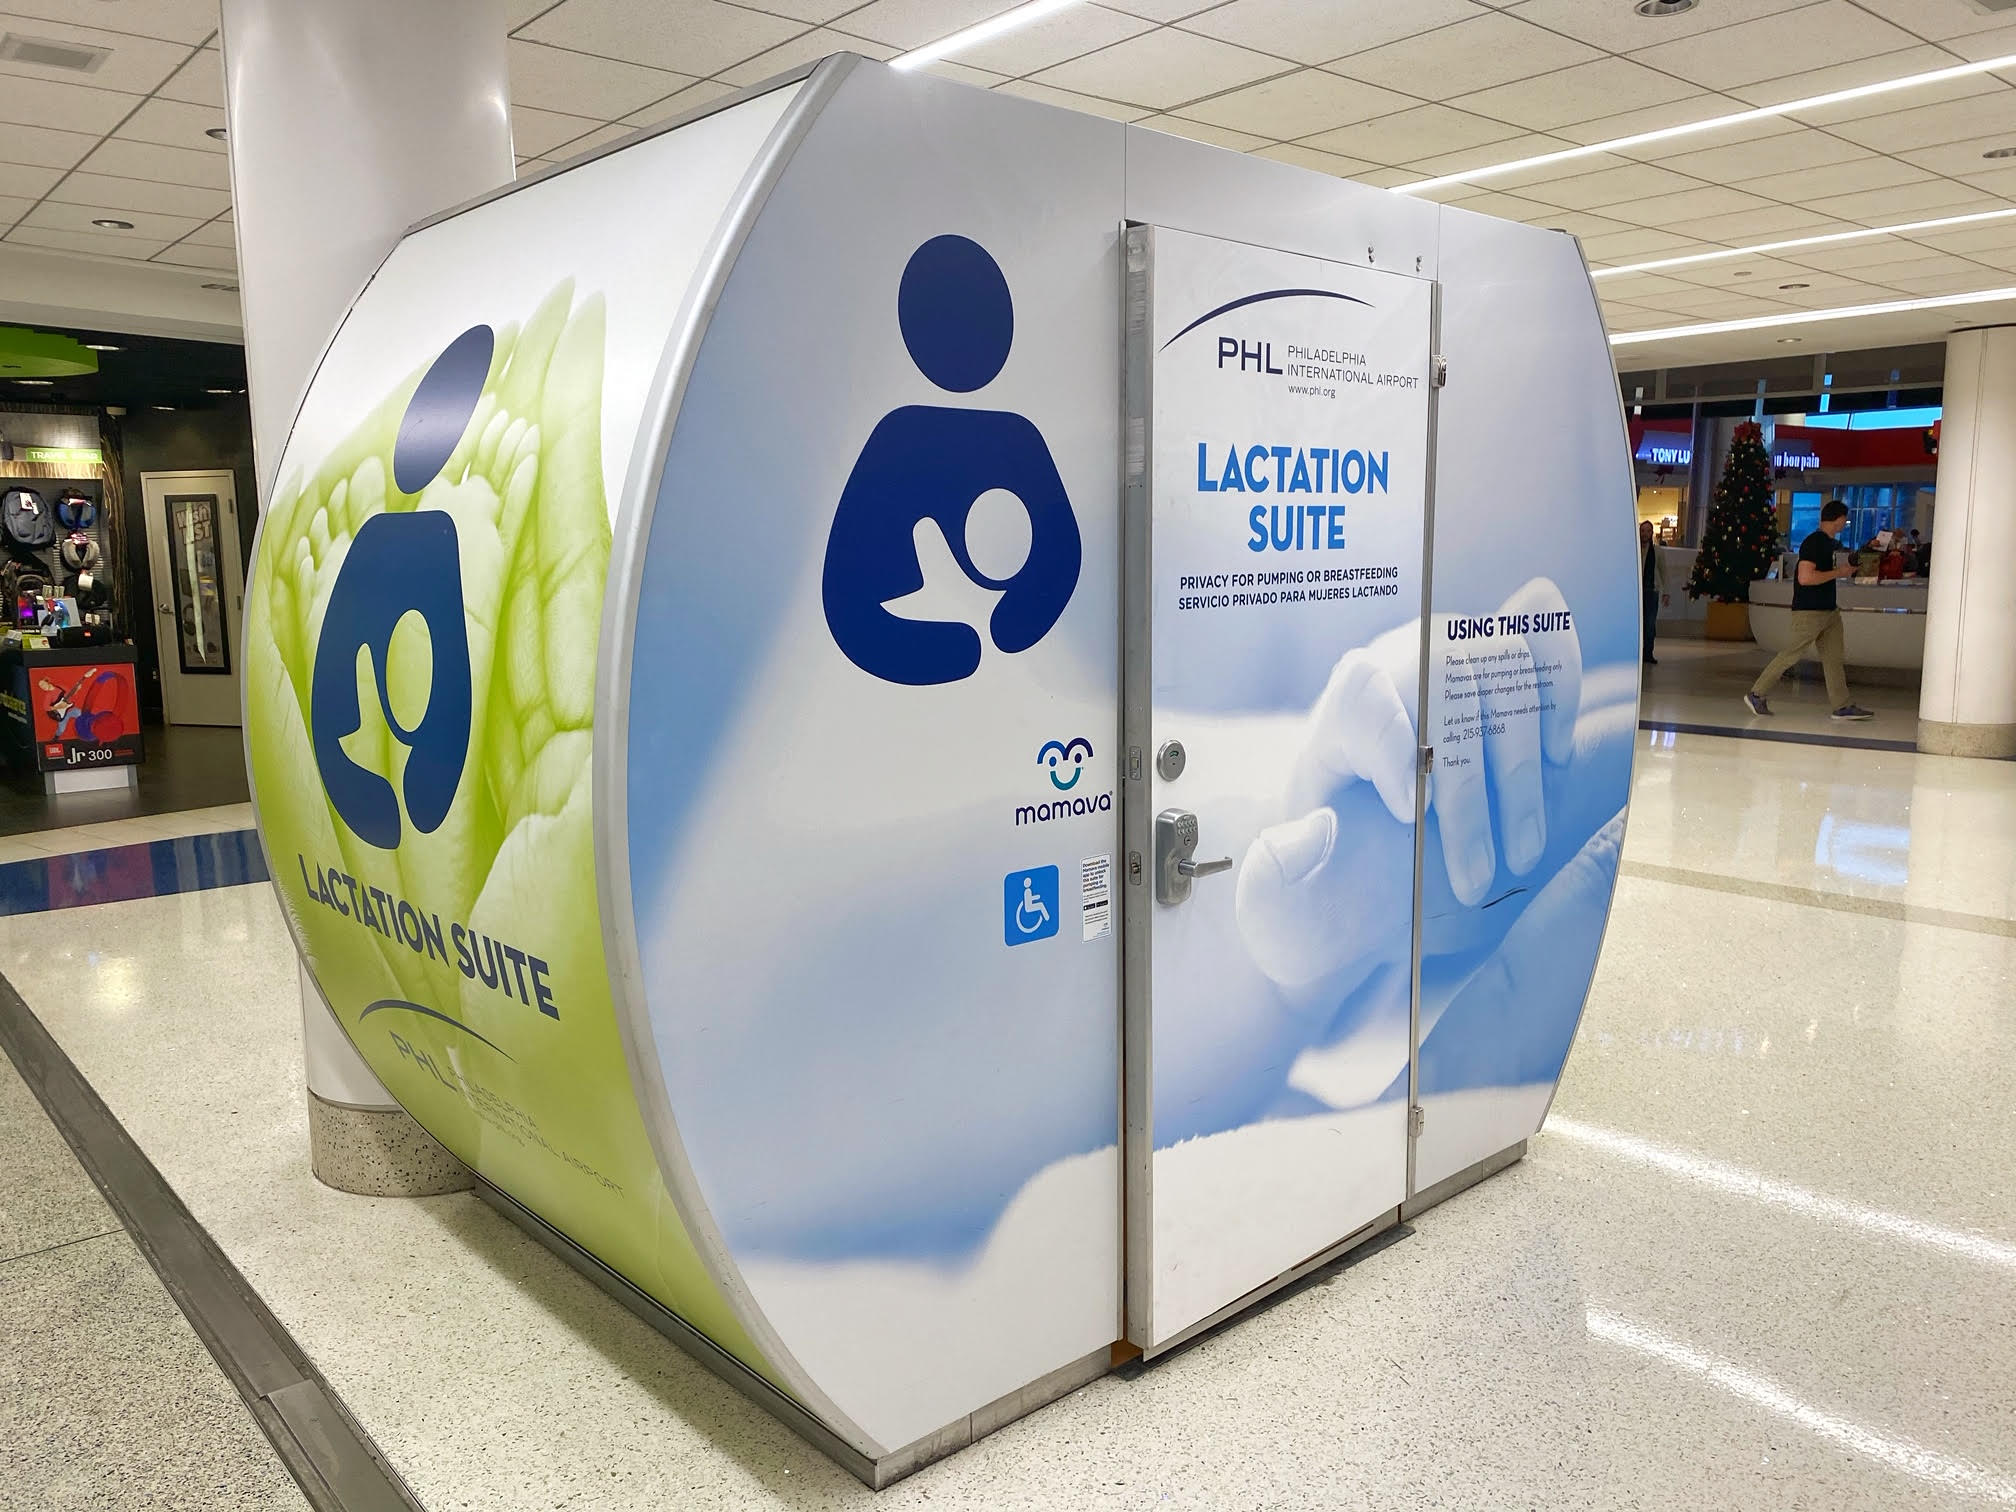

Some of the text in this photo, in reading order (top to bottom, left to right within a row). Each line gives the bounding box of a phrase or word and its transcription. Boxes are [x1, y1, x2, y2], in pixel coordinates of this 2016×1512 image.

[1218, 336, 1366, 375] PHL PHILADELPHIA
[1287, 364, 1419, 389] INTERNATIONAL AIRPORT
[1288, 385, 1336, 399] www.phl.org
[1652, 448, 1677, 463] TONY
[1783, 451, 1800, 467] bon
[1800, 452, 1819, 472] pain
[1198, 442, 1389, 495] LACTATION
[1248, 504, 1346, 553] SUITE
[1180, 566, 1398, 590] PRIVACY FOR PUMPING OR BREASTFEEDING
[1179, 584, 1398, 610] SERVICIO PRIVADO PARA MUJERES LACTANDO
[1447, 611, 1571, 640] USING THIS SUITE
[1446, 655, 1464, 666] Please
[1466, 652, 1480, 664] clean
[1480, 656, 1487, 665] up
[1488, 655, 1498, 663] any
[1498, 648, 1510, 663] spills
[1445, 673, 1472, 683] Mamavas
[1491, 669, 1512, 680] pumping
[1445, 689, 1463, 700] Please
[1477, 685, 1493, 699] diaper
[1494, 682, 1515, 696] changes
[1524, 680, 1532, 690] the
[1444, 715, 1454, 726] Let
[1461, 713, 1475, 723] know
[1481, 709, 1490, 720] this
[1491, 708, 1513, 719] Mamava
[1514, 706, 1528, 715] needs
[1551, 700, 1557, 712] by
[1442, 731, 1461, 744] calling
[67, 747, 86, 765] Jr
[88, 749, 112, 761] 300
[1442, 754, 1460, 768] Thank
[298, 853, 560, 1022] LACTATION SUITE
[389, 1030, 458, 1092] PHL
